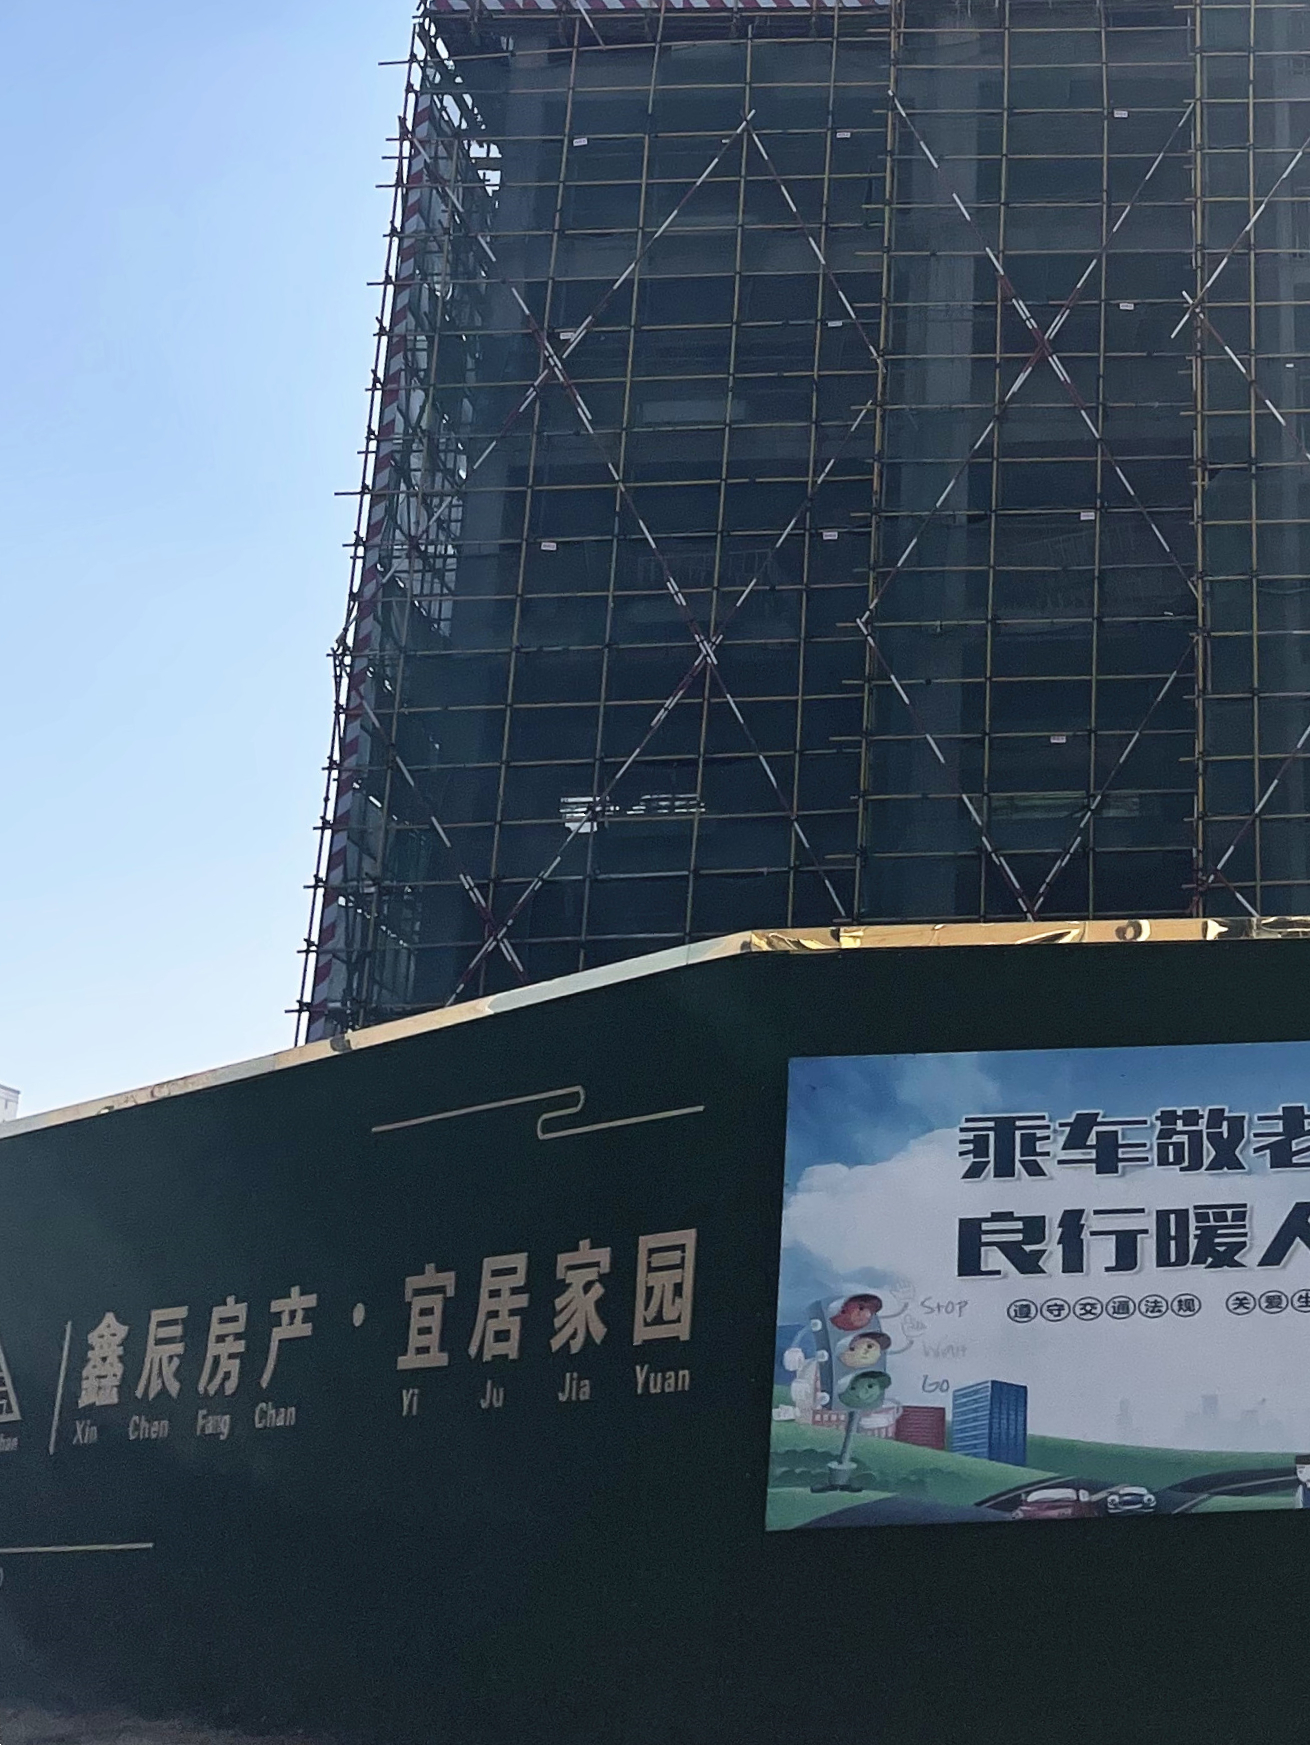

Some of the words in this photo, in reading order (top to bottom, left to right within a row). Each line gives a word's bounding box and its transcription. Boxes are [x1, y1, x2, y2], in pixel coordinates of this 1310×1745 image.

[1007, 1293, 1201, 1323] 遵守交通法规
[72, 1420, 97, 1445] Xin
[128, 1415, 169, 1441] Chen
[196, 1409, 231, 1440] Fang
[254, 1403, 296, 1429] Chan
[402, 1389, 419, 1416] Yi
[480, 1380, 504, 1409] Ju
[558, 1372, 591, 1402] Jia
[635, 1364, 690, 1394] Yuan
